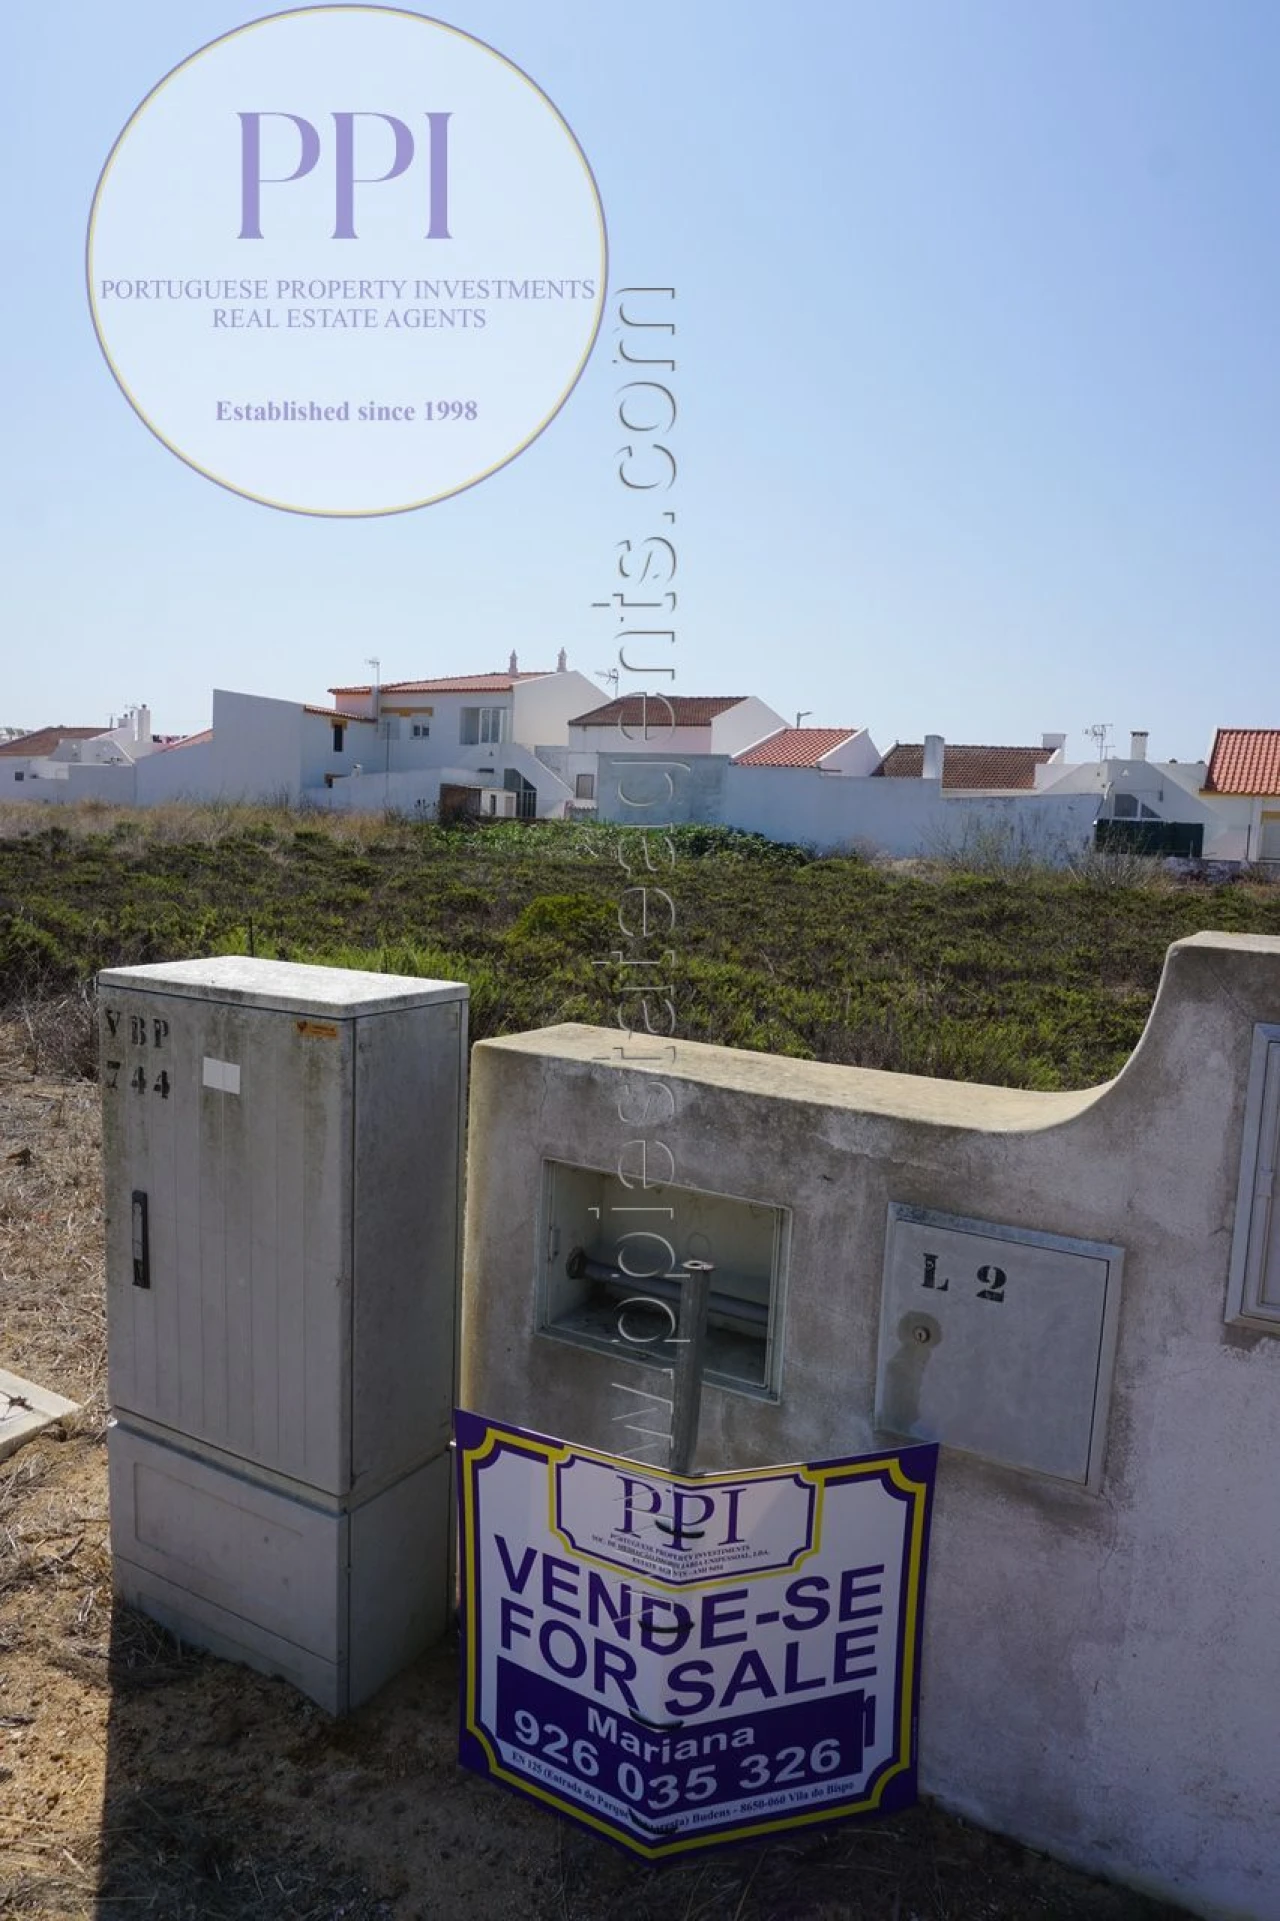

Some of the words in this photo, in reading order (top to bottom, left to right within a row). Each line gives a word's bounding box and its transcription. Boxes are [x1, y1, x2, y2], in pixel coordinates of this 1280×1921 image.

[921, 1253, 949, 1291] L
[976, 1265, 1007, 1303] 2
[614, 1475, 747, 1552] PPI
[494, 1534, 885, 1656] VENDE-SE
[500, 1597, 642, 1712] FOR
[664, 1625, 879, 1717] SALE
[514, 1709, 599, 1778] 926
[617, 1761, 718, 1811] 035
[740, 1738, 841, 1790] 326
[587, 1706, 755, 1764] Mariana
[512, 1752, 525, 1765] EN
[527, 1758, 543, 1775] 125
[544, 1767, 582, 1796] (Entrada
[584, 1789, 595, 1801] do
[597, 1795, 629, 1818] Parque
[692, 1809, 731, 1824] Budens
[788, 1790, 809, 1803] Vila
[811, 1787, 824, 1798] do
[826, 1782, 855, 1797] Bispo
